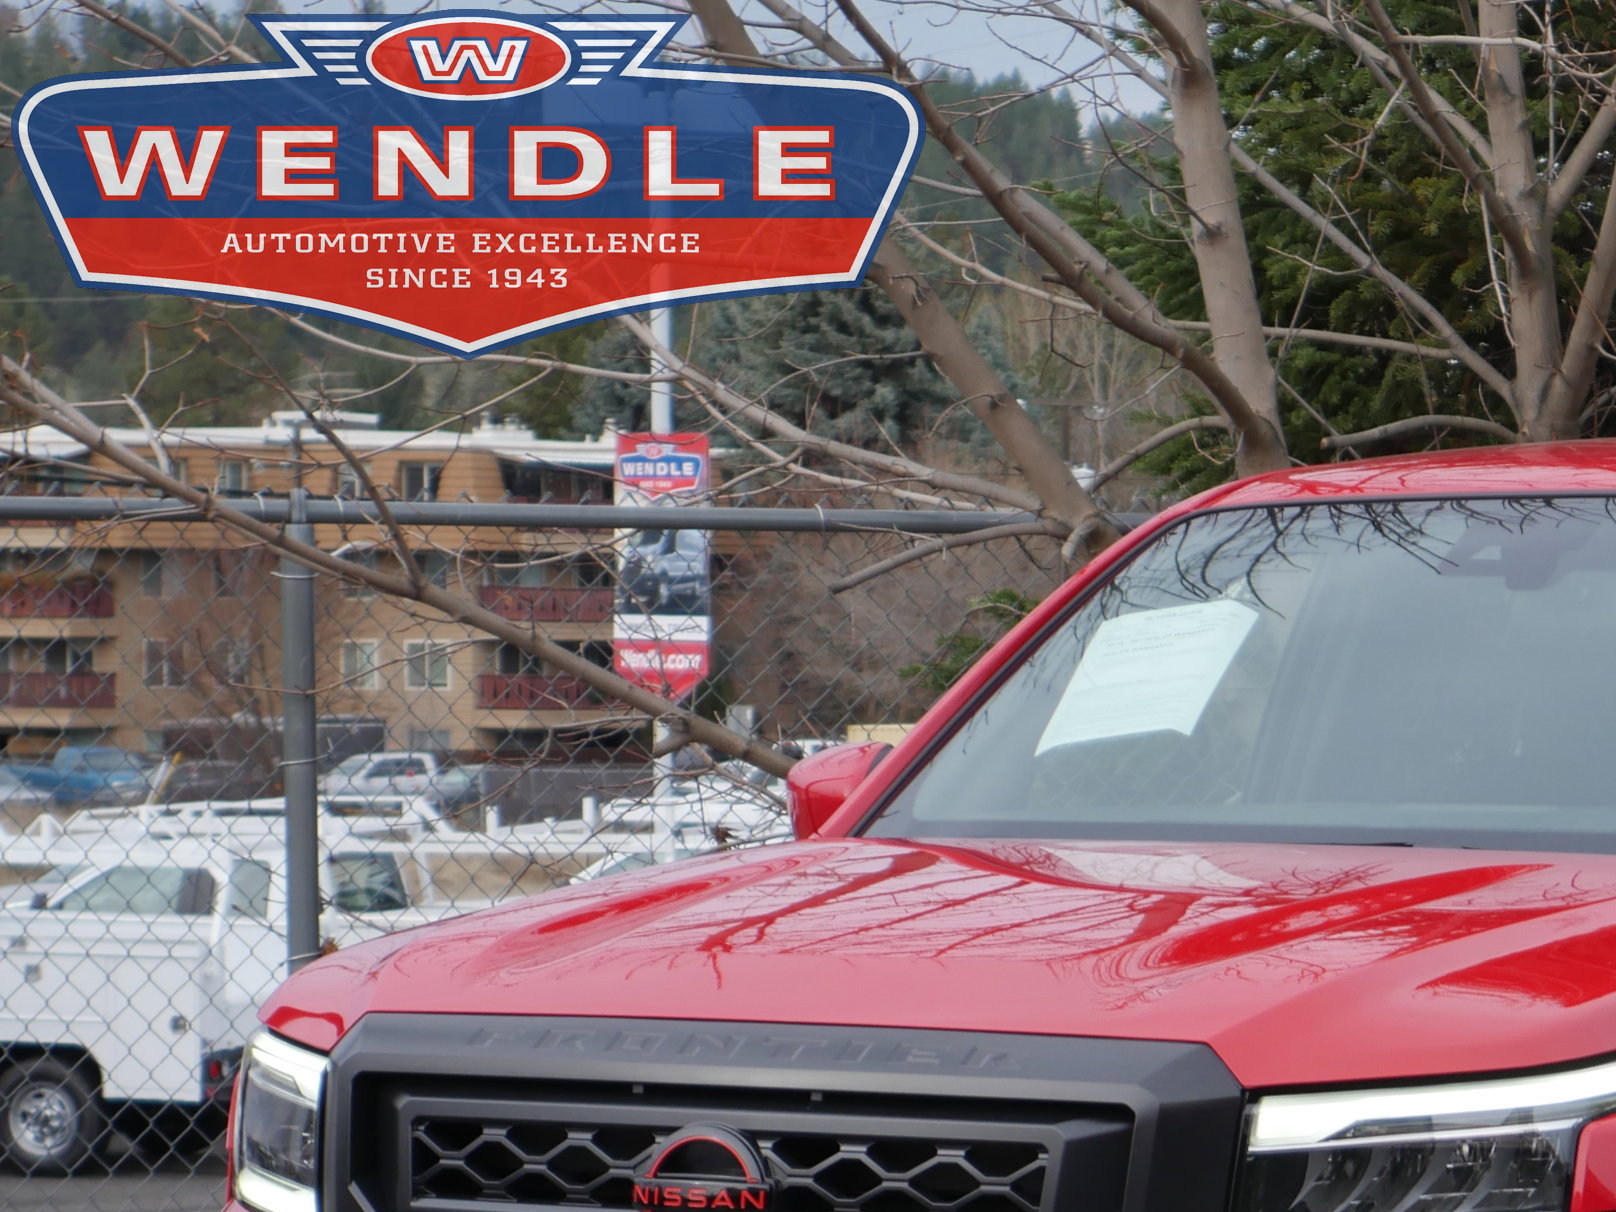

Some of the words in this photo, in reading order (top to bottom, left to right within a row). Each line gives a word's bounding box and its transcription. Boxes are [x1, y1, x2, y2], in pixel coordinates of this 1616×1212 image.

[622, 462, 694, 476] WENDLE
[466, 1026, 1022, 1070] FRONTIER
[633, 1184, 766, 1210] NISSAN
